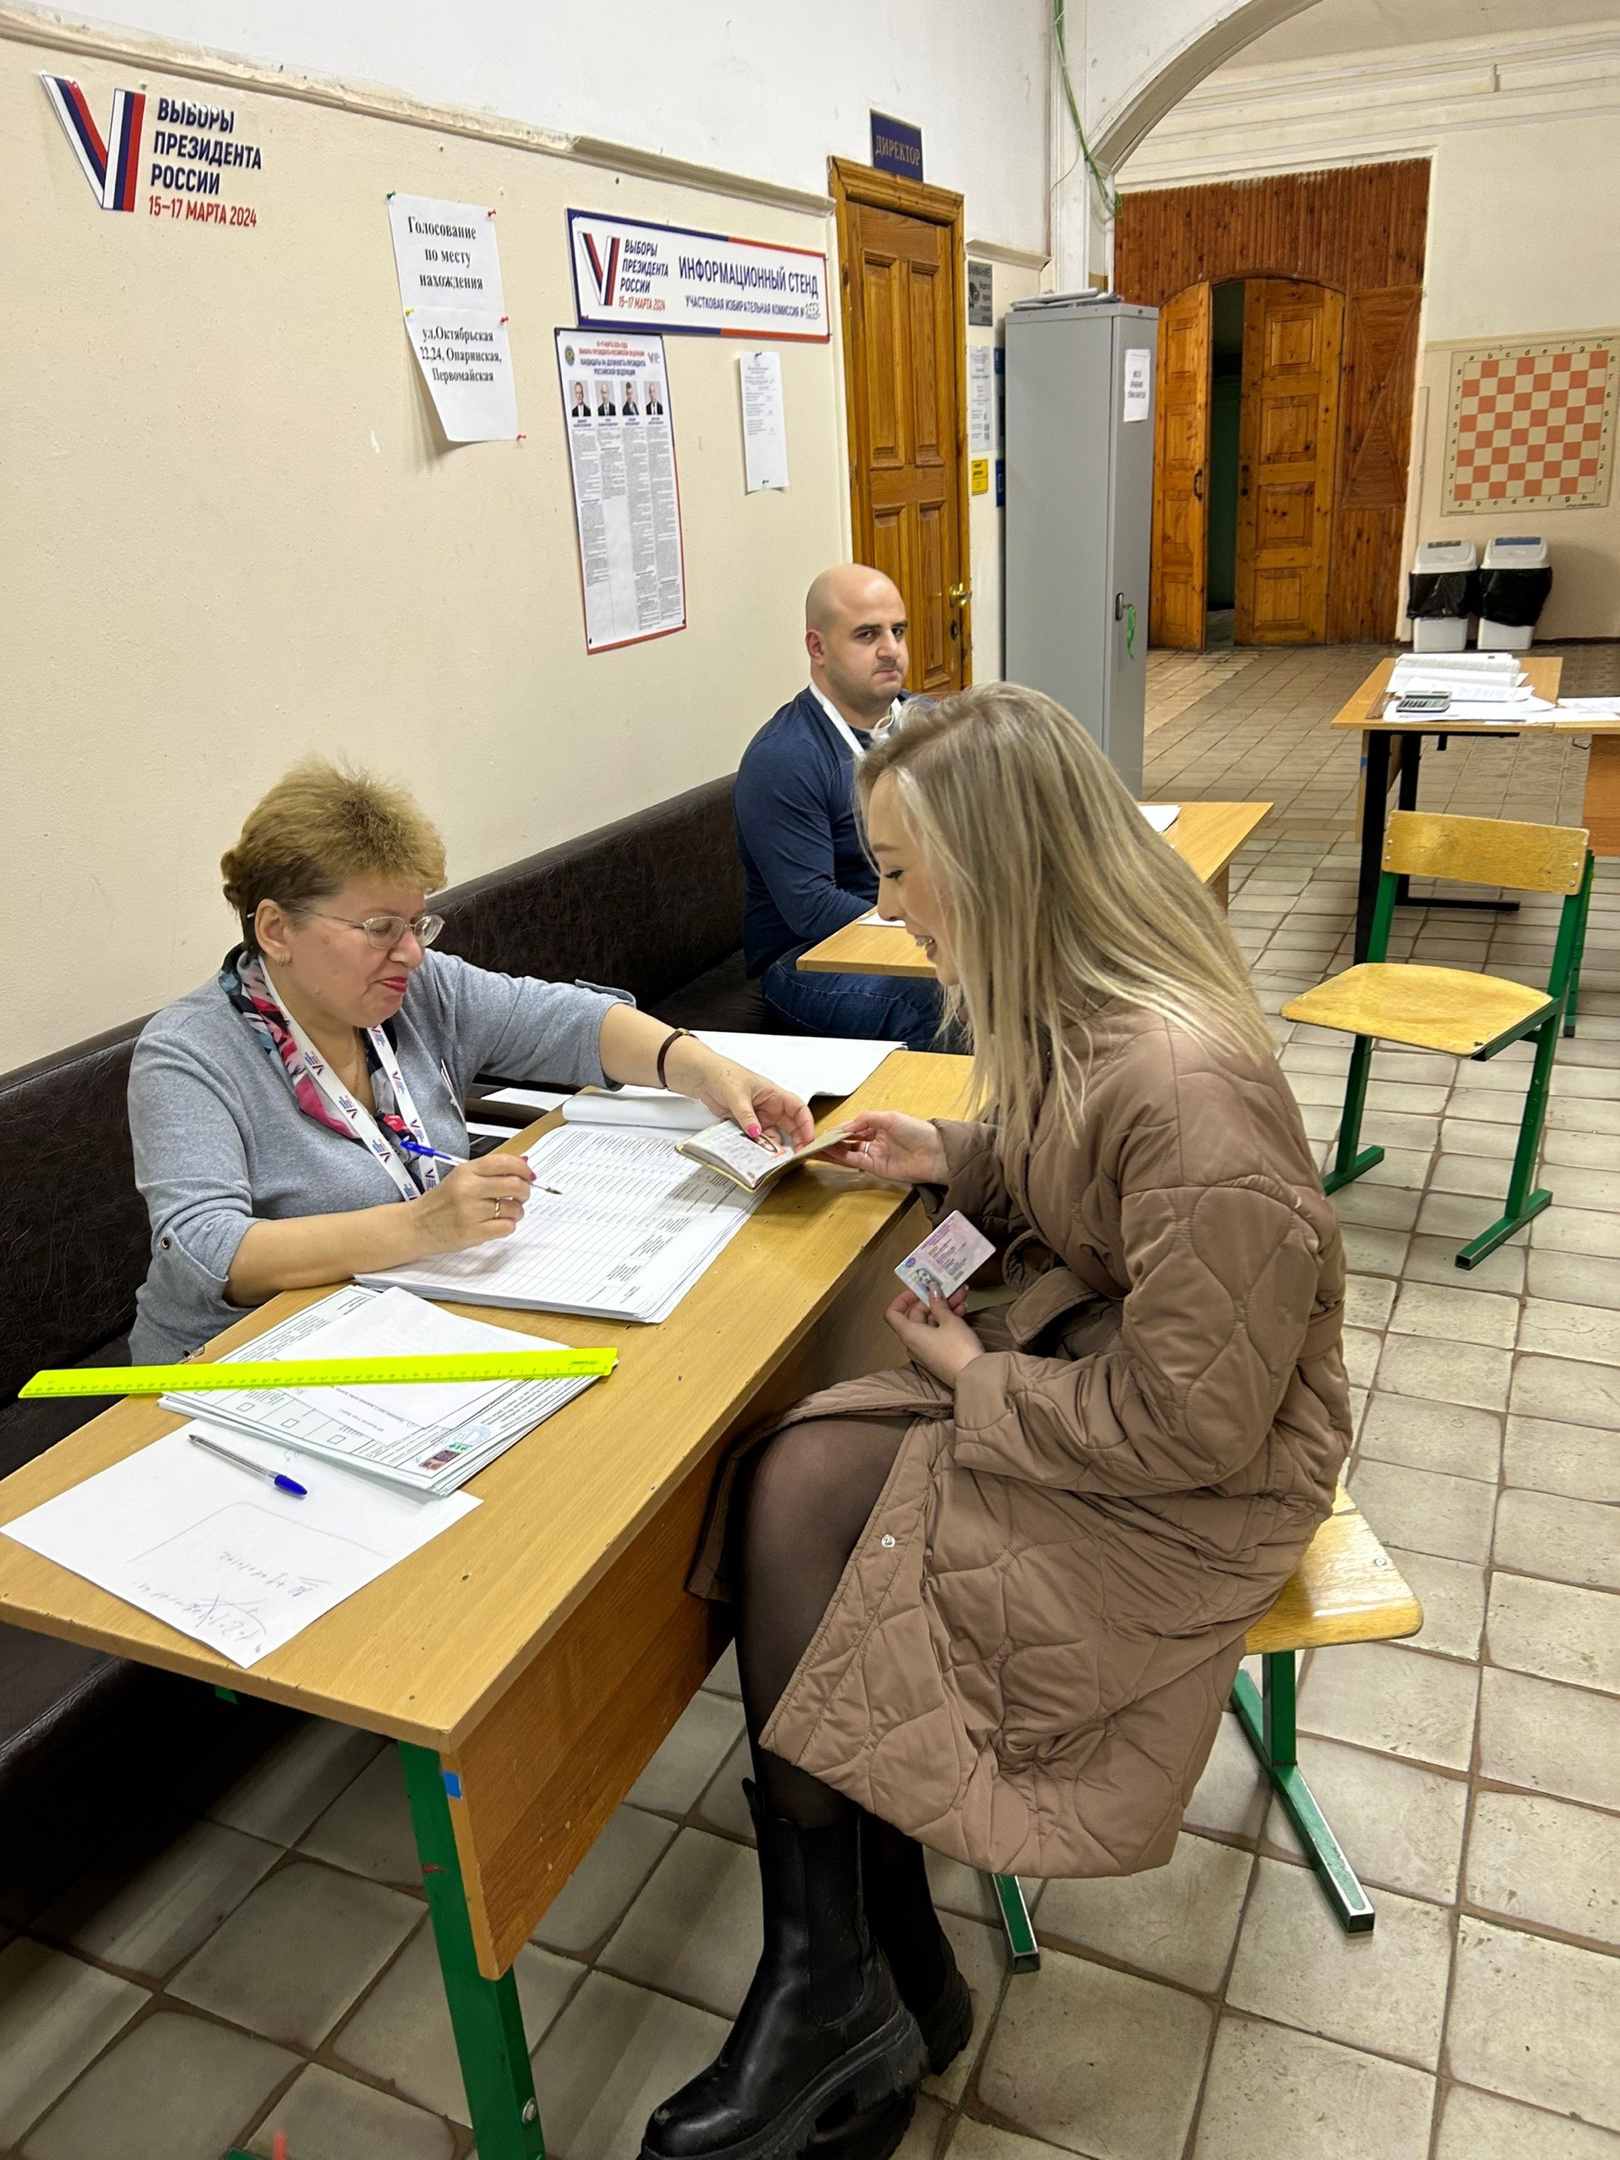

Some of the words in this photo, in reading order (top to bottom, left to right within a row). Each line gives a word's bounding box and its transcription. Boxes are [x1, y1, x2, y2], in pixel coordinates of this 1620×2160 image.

[157, 97, 235, 134] ВЫБОРЫ
[153, 130, 262, 170] ПРЕЗИДЕНТА
[875, 135, 921, 166] ДИРЕКТОР
[150, 163, 221, 195] РОССИИ
[185, 199, 227, 225] МАРТА
[229, 205, 257, 228] 2024
[407, 216, 477, 240] Голосование
[624, 238, 658, 257] ВЫБОРЫ
[424, 248, 438, 262] по
[440, 251, 471, 268] месту
[621, 258, 669, 278] ПРЕЗИДЕНТА
[419, 273, 484, 290] нахождения
[620, 277, 651, 294] РОССИИ
[678, 255, 787, 292] ИНФОРМАЦИОННЫЙ
[788, 271, 819, 300] СТЕНД
[422, 326, 494, 344] ул.Октябрьская
[446, 347, 502, 365] Опаринская,
[432, 367, 495, 384] Первомайская
